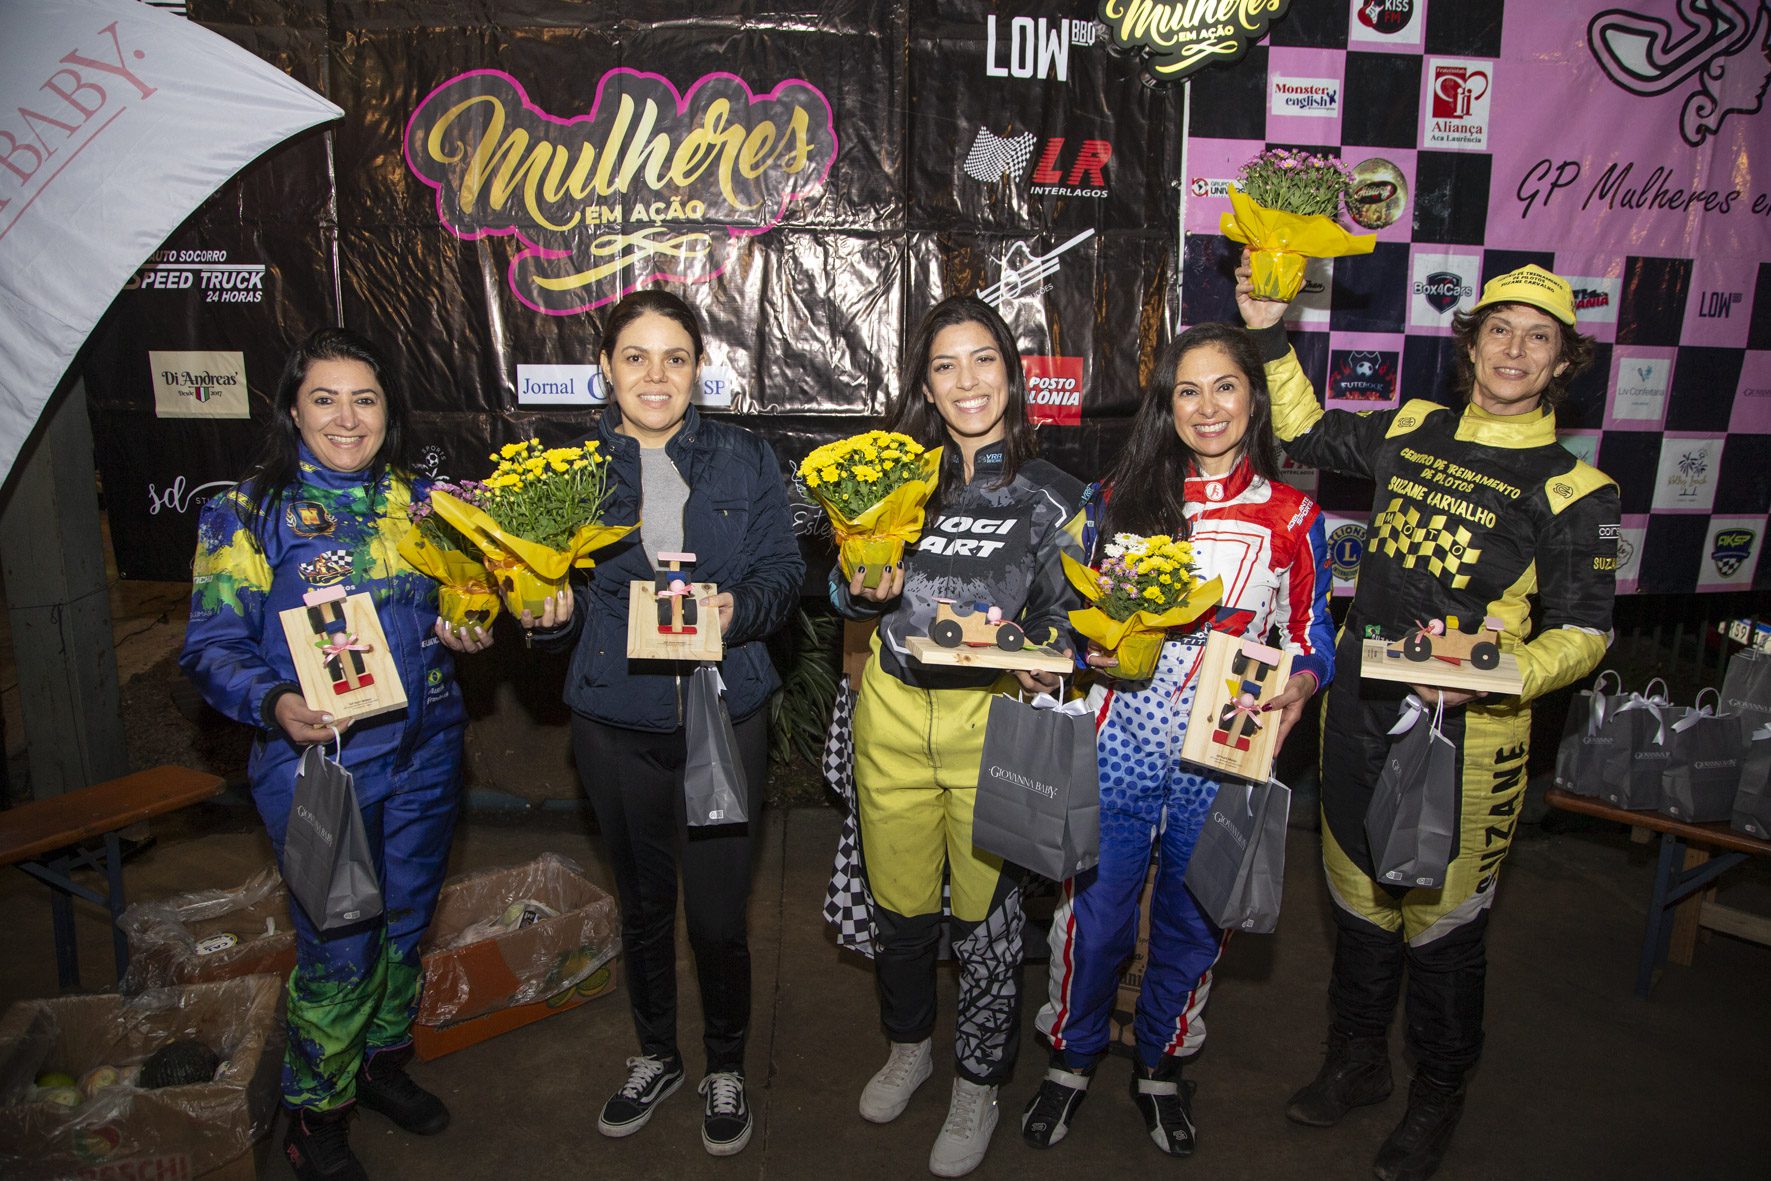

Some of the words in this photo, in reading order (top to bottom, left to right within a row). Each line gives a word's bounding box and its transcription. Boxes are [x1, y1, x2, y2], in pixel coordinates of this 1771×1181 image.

[1385, 0, 1409, 12] KISS
[1385, 11, 1402, 23] FM
[1178, 30, 1197, 42] EM
[1199, 25, 1235, 41] AÇÃO
[986, 14, 1069, 81] LOW
[1071, 20, 1096, 47] BBQ
[1275, 83, 1329, 95] Monster
[1285, 95, 1328, 109] english
[1431, 120, 1483, 136] Aliança
[1446, 134, 1482, 143] Laurência
[428, 93, 815, 231] Mulheres
[1031, 137, 1113, 186] LR
[1030, 186, 1109, 199] INTERLAGOS
[1516, 158, 1581, 219] GP
[1581, 162, 1741, 214] Mulheres
[585, 207, 621, 226] EM
[629, 199, 705, 226] AÇÃO
[179, 250, 227, 262] SOCORRO
[200, 270, 265, 289] TRUCK
[206, 291, 219, 303] 24
[221, 291, 263, 303] HORAS
[1412, 281, 1473, 297] Box4Cars
[1698, 291, 1733, 319] LOW
[161, 371, 179, 386] Di
[1029, 376, 1076, 390] POSTO
[177, 390, 195, 398] Desde
[210, 390, 223, 398] 2017
[523, 377, 576, 397] Jornal
[703, 380, 726, 396] SP
[421, 444, 447, 461] SPORTS
[1400, 447, 1435, 466] CENTRO
[1433, 458, 1448, 471] DE
[1420, 467, 1436, 480] DE
[1387, 475, 1429, 501] SUZANE
[932, 515, 1018, 536] OGI
[1334, 526, 1367, 540] LIONS
[990, 765, 1035, 787] GIOVANNA
[1475, 742, 1526, 894] SUZANE
